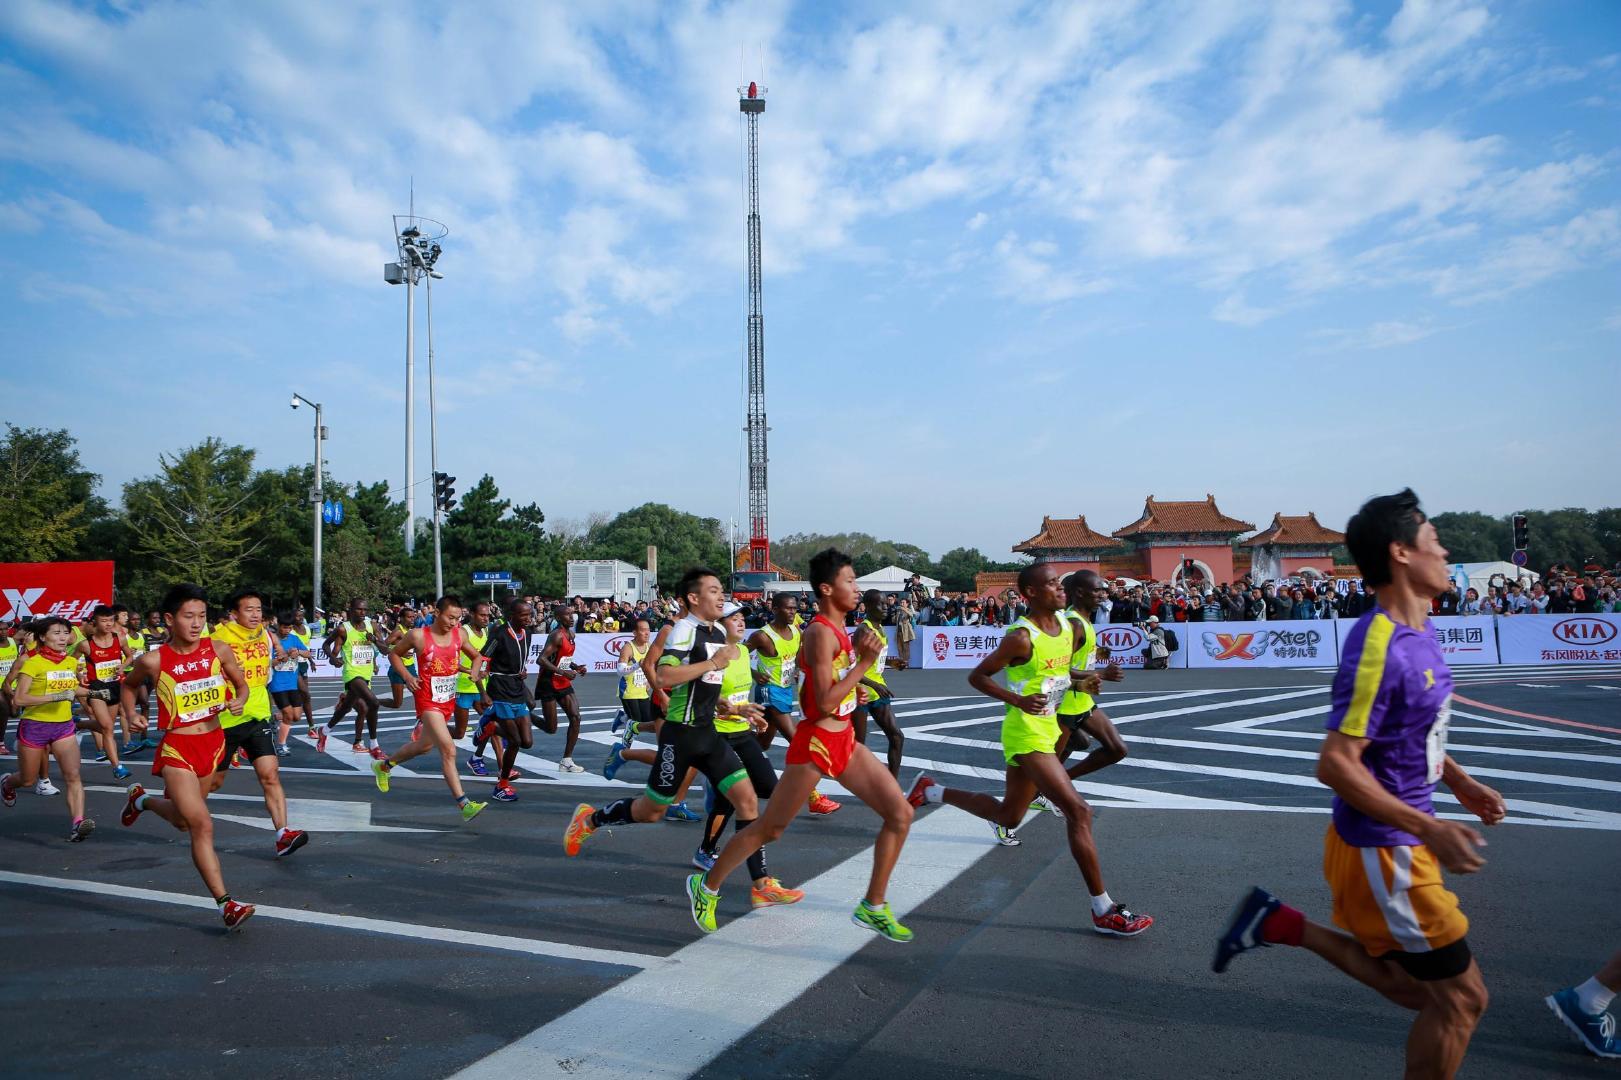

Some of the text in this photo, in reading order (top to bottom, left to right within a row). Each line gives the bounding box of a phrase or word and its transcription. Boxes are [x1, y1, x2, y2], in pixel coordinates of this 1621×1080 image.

[1269, 630, 1321, 647] Xtep
[1564, 624, 1607, 638] KIA
[954, 635, 1004, 650] 智美体
[1102, 635, 1134, 646] KIA
[1273, 646, 1318, 659] 特步儿童
[1541, 649, 1621, 661] 东风悦达·起
[172, 658, 210, 676] 根河市
[182, 688, 220, 708] 23130
[658, 743, 675, 787] KOOSA
